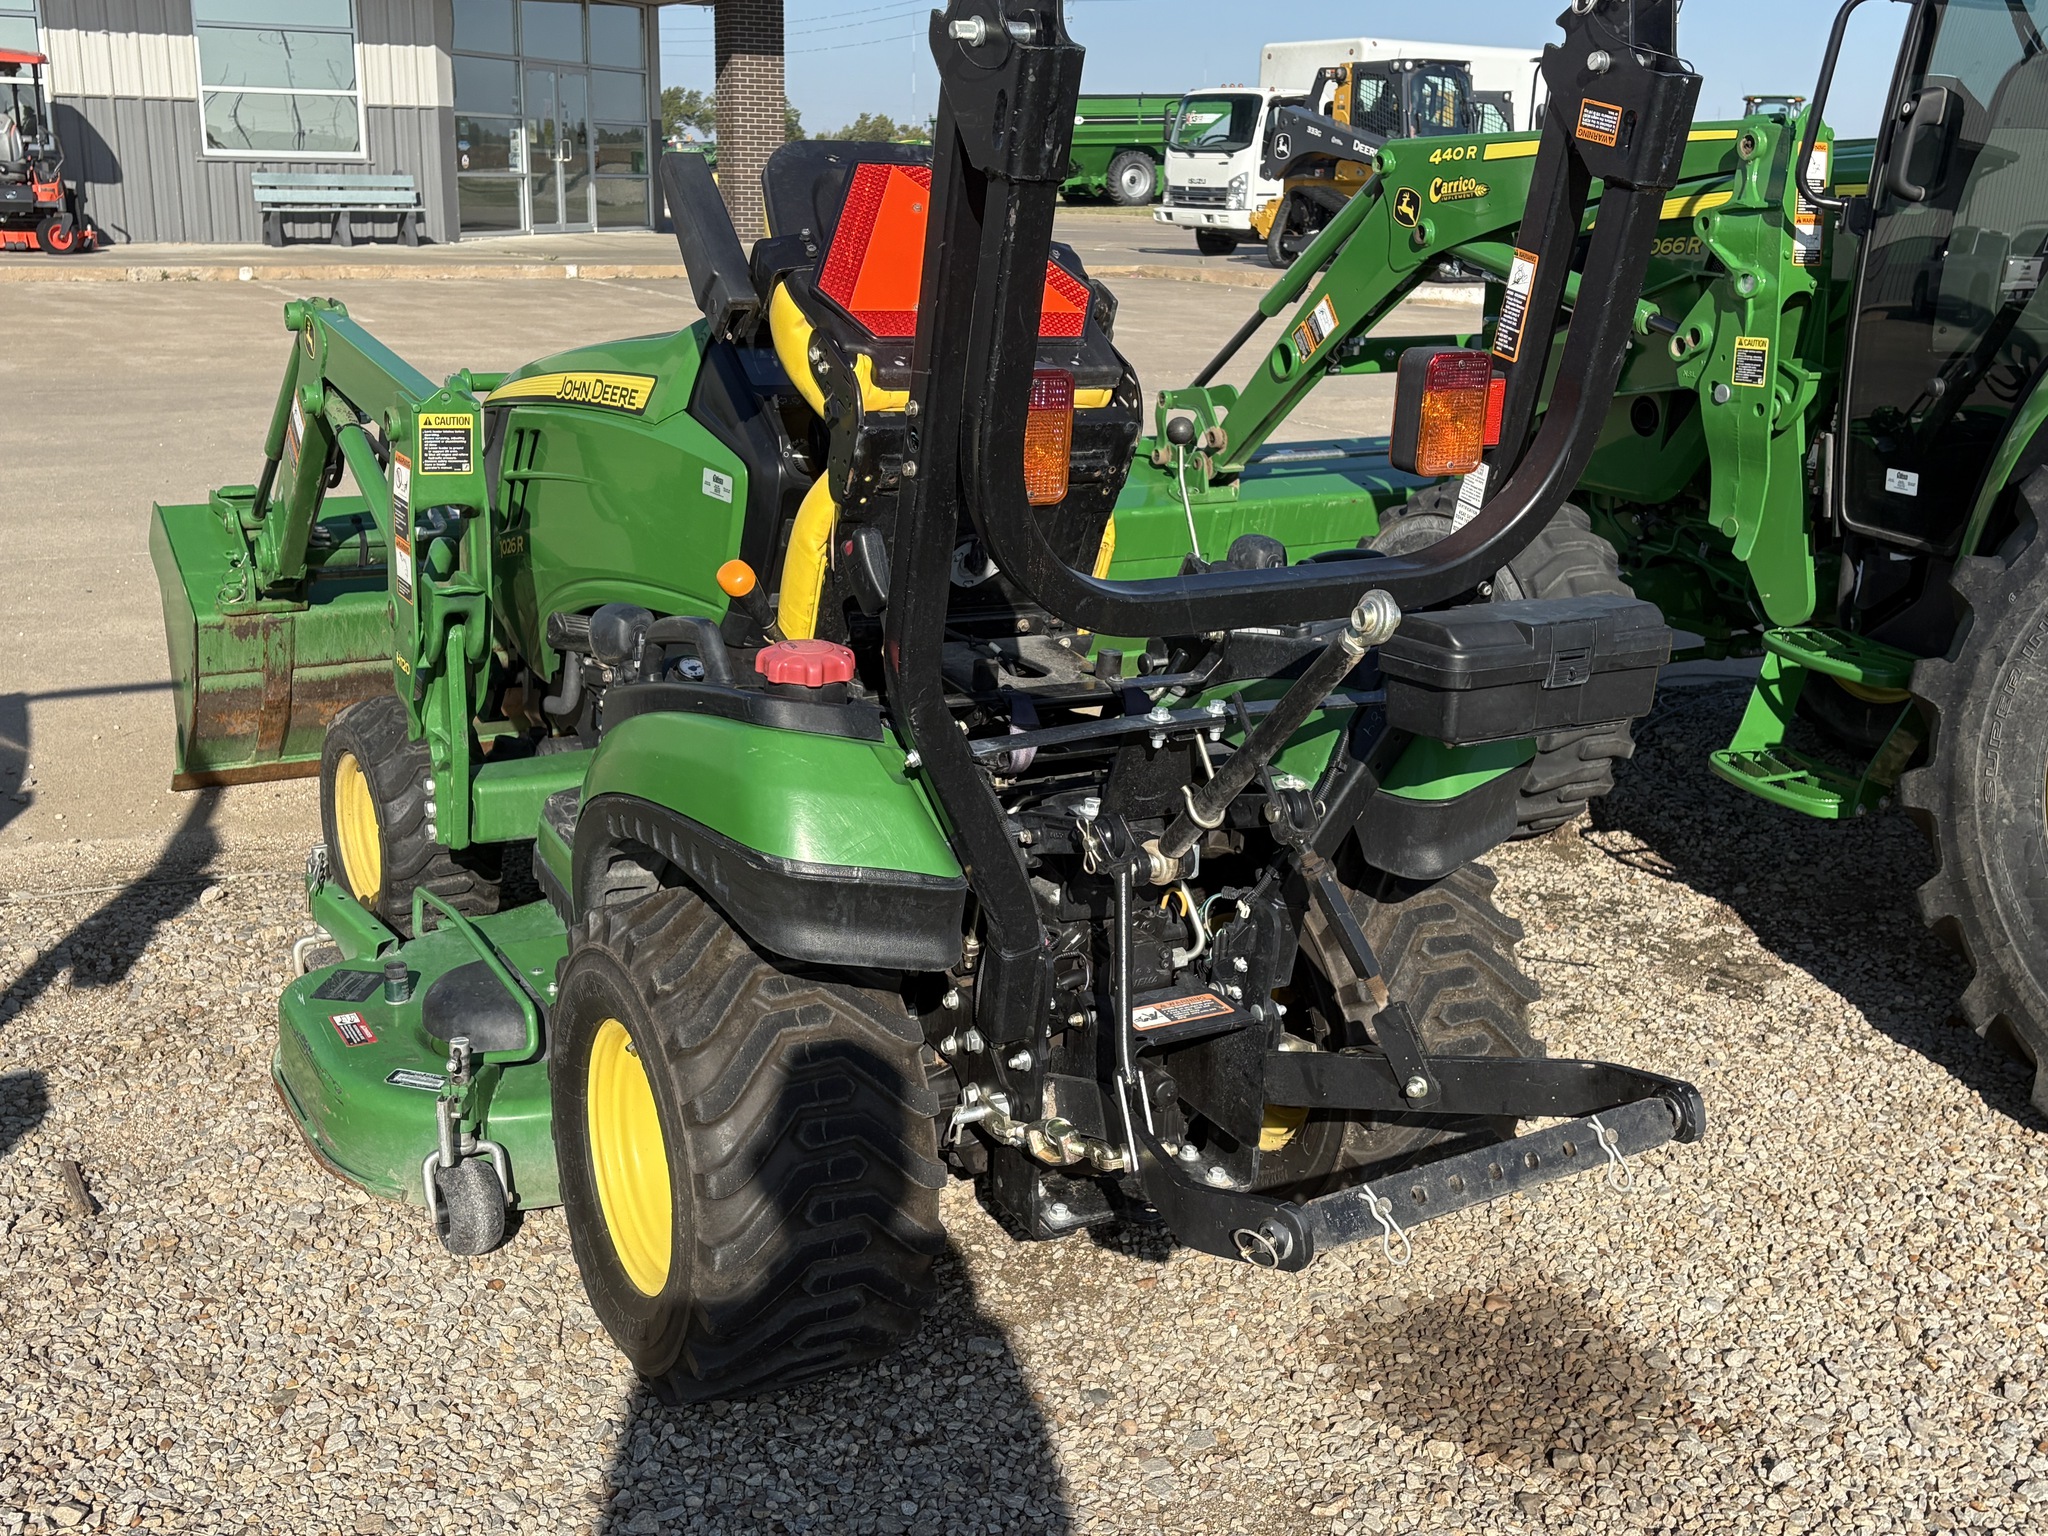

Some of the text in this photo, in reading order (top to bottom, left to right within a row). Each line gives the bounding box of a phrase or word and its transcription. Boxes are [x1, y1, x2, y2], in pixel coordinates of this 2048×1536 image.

[1578, 128, 1608, 144] WARNING
[1353, 139, 1379, 157] DEER
[1429, 175, 1476, 203] Carrico
[1744, 338, 1767, 347] CAUTION
[556, 376, 639, 406] JOHN DEERE
[434, 416, 470, 426] CAUTION
[1984, 668, 2023, 804] SUPER
